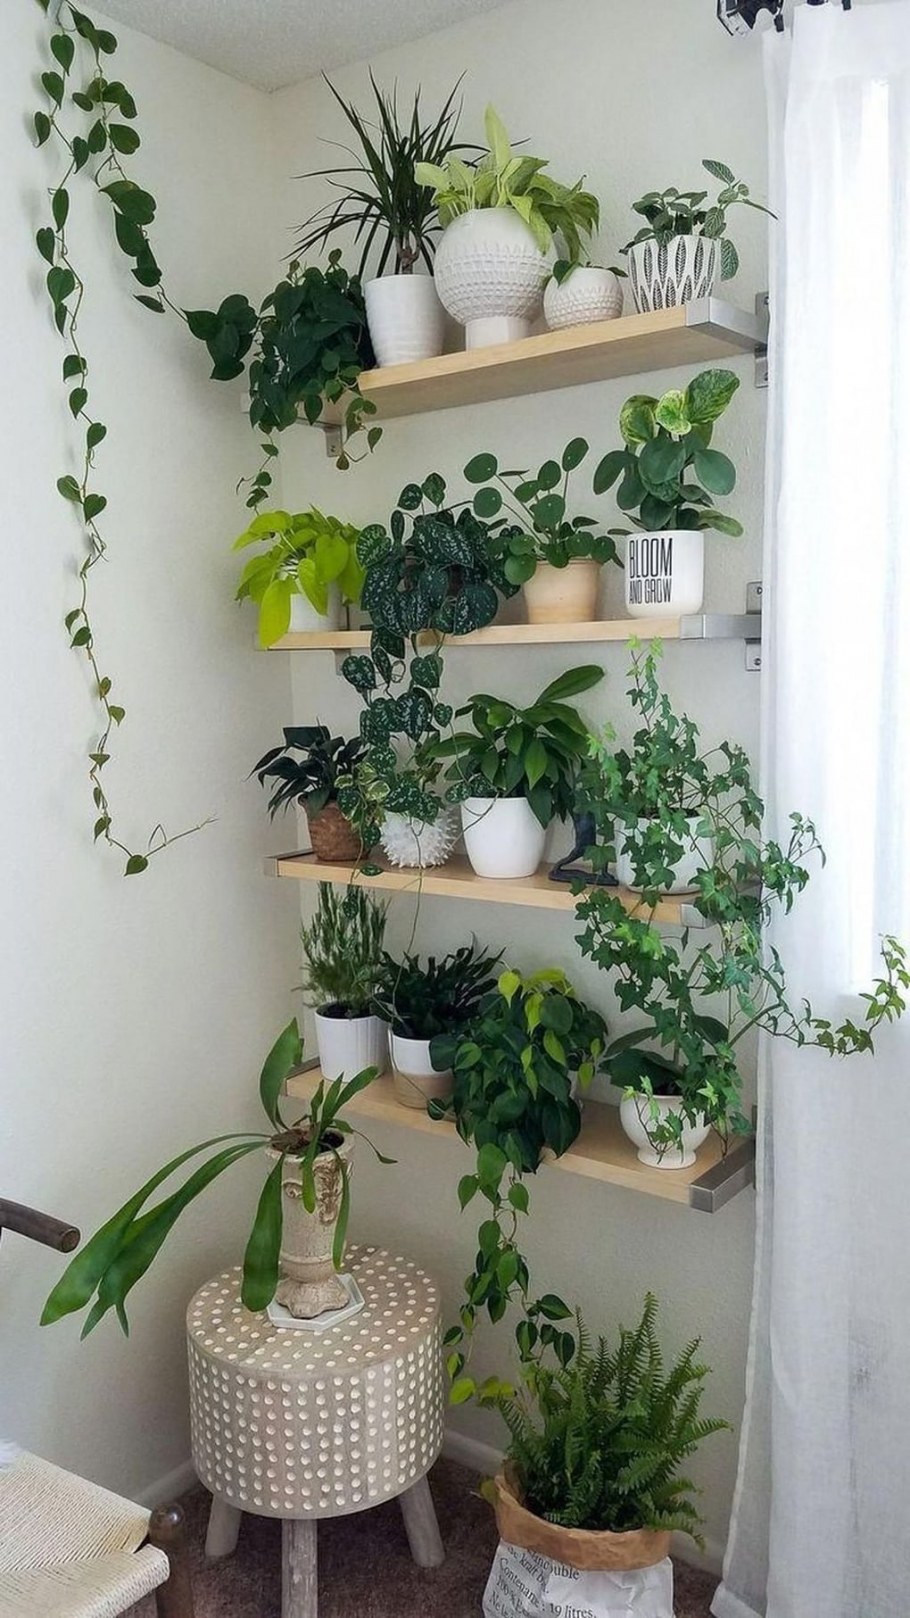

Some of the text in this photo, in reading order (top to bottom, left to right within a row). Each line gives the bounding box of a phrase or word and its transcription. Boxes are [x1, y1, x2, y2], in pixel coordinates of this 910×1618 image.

[630, 537, 672, 578] BLOOM
[629, 578, 672, 604] AND GROW
[550, 1603, 562, 1618] 19
